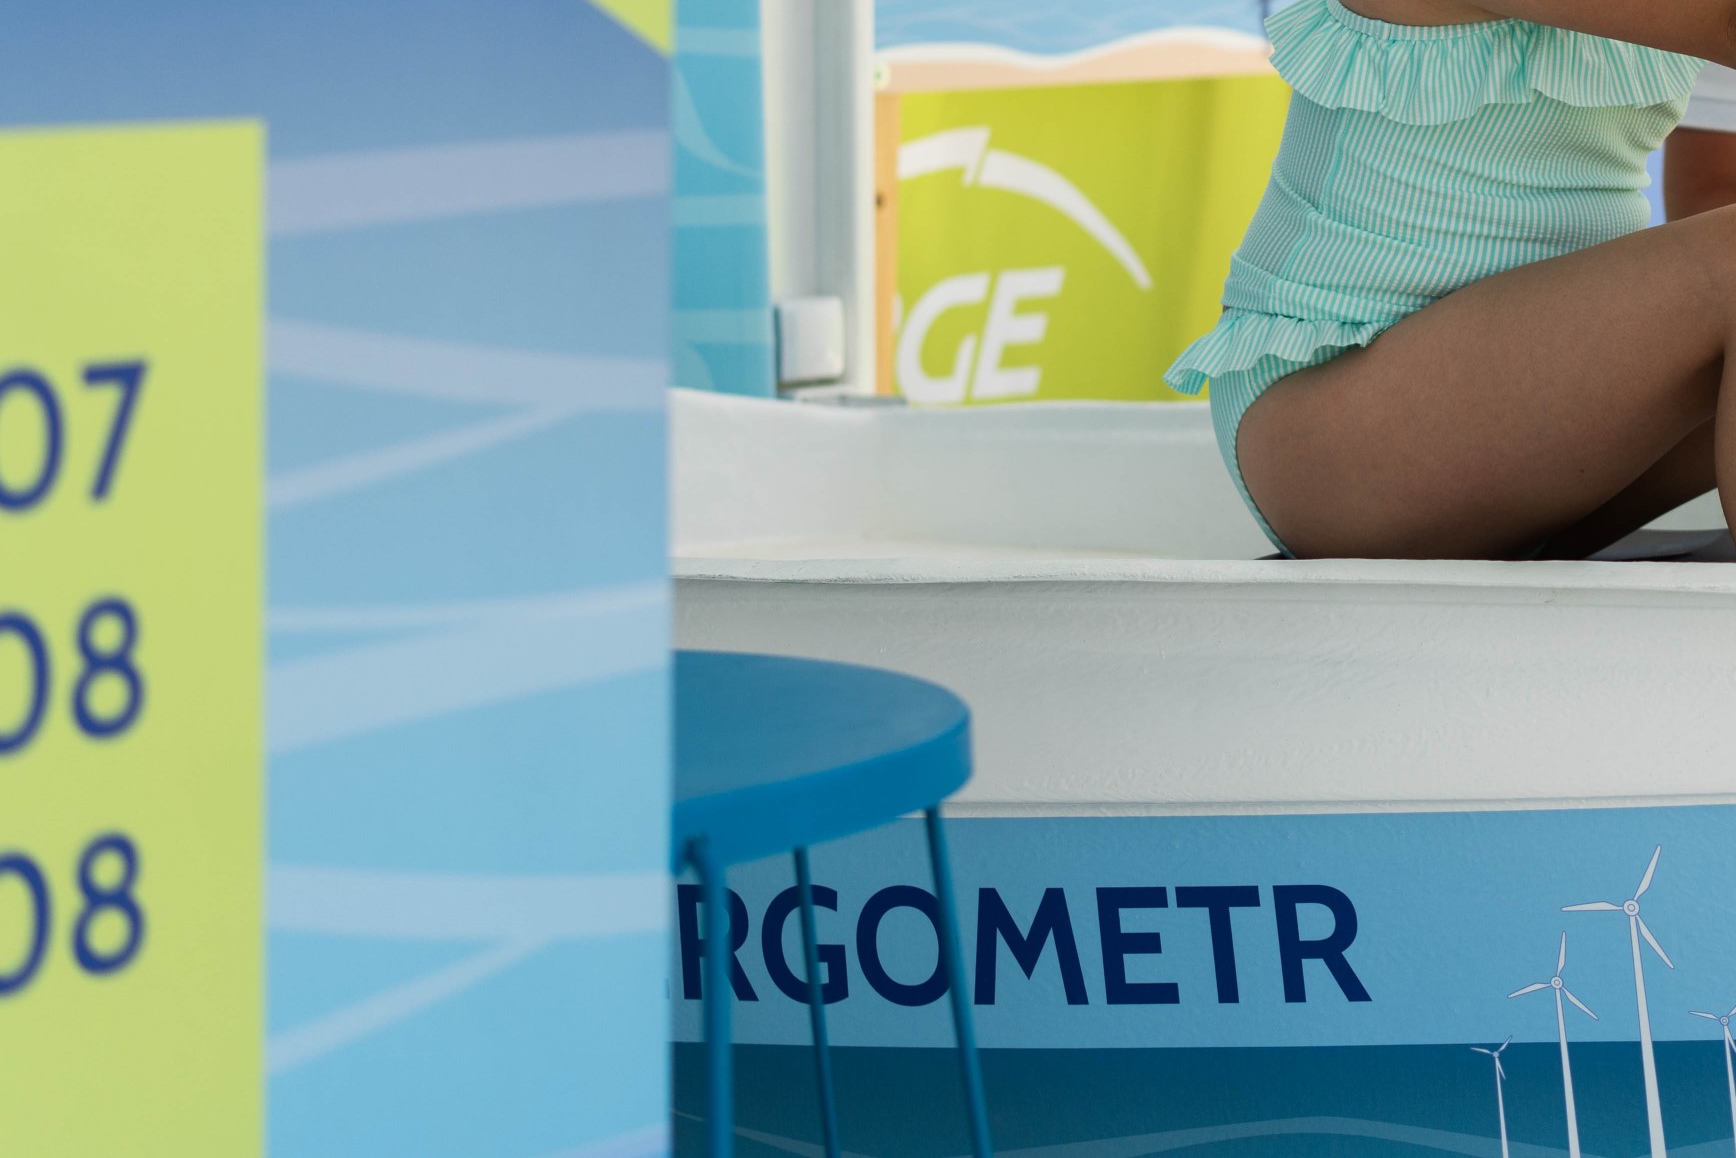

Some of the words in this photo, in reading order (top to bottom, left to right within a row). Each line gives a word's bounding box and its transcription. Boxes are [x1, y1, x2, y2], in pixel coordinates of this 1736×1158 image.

[893, 265, 1066, 404] GE
[0, 359, 148, 513] 07
[0, 596, 146, 758] 08
[0, 832, 146, 996] 08
[665, 884, 1373, 1008] RGOMETR
